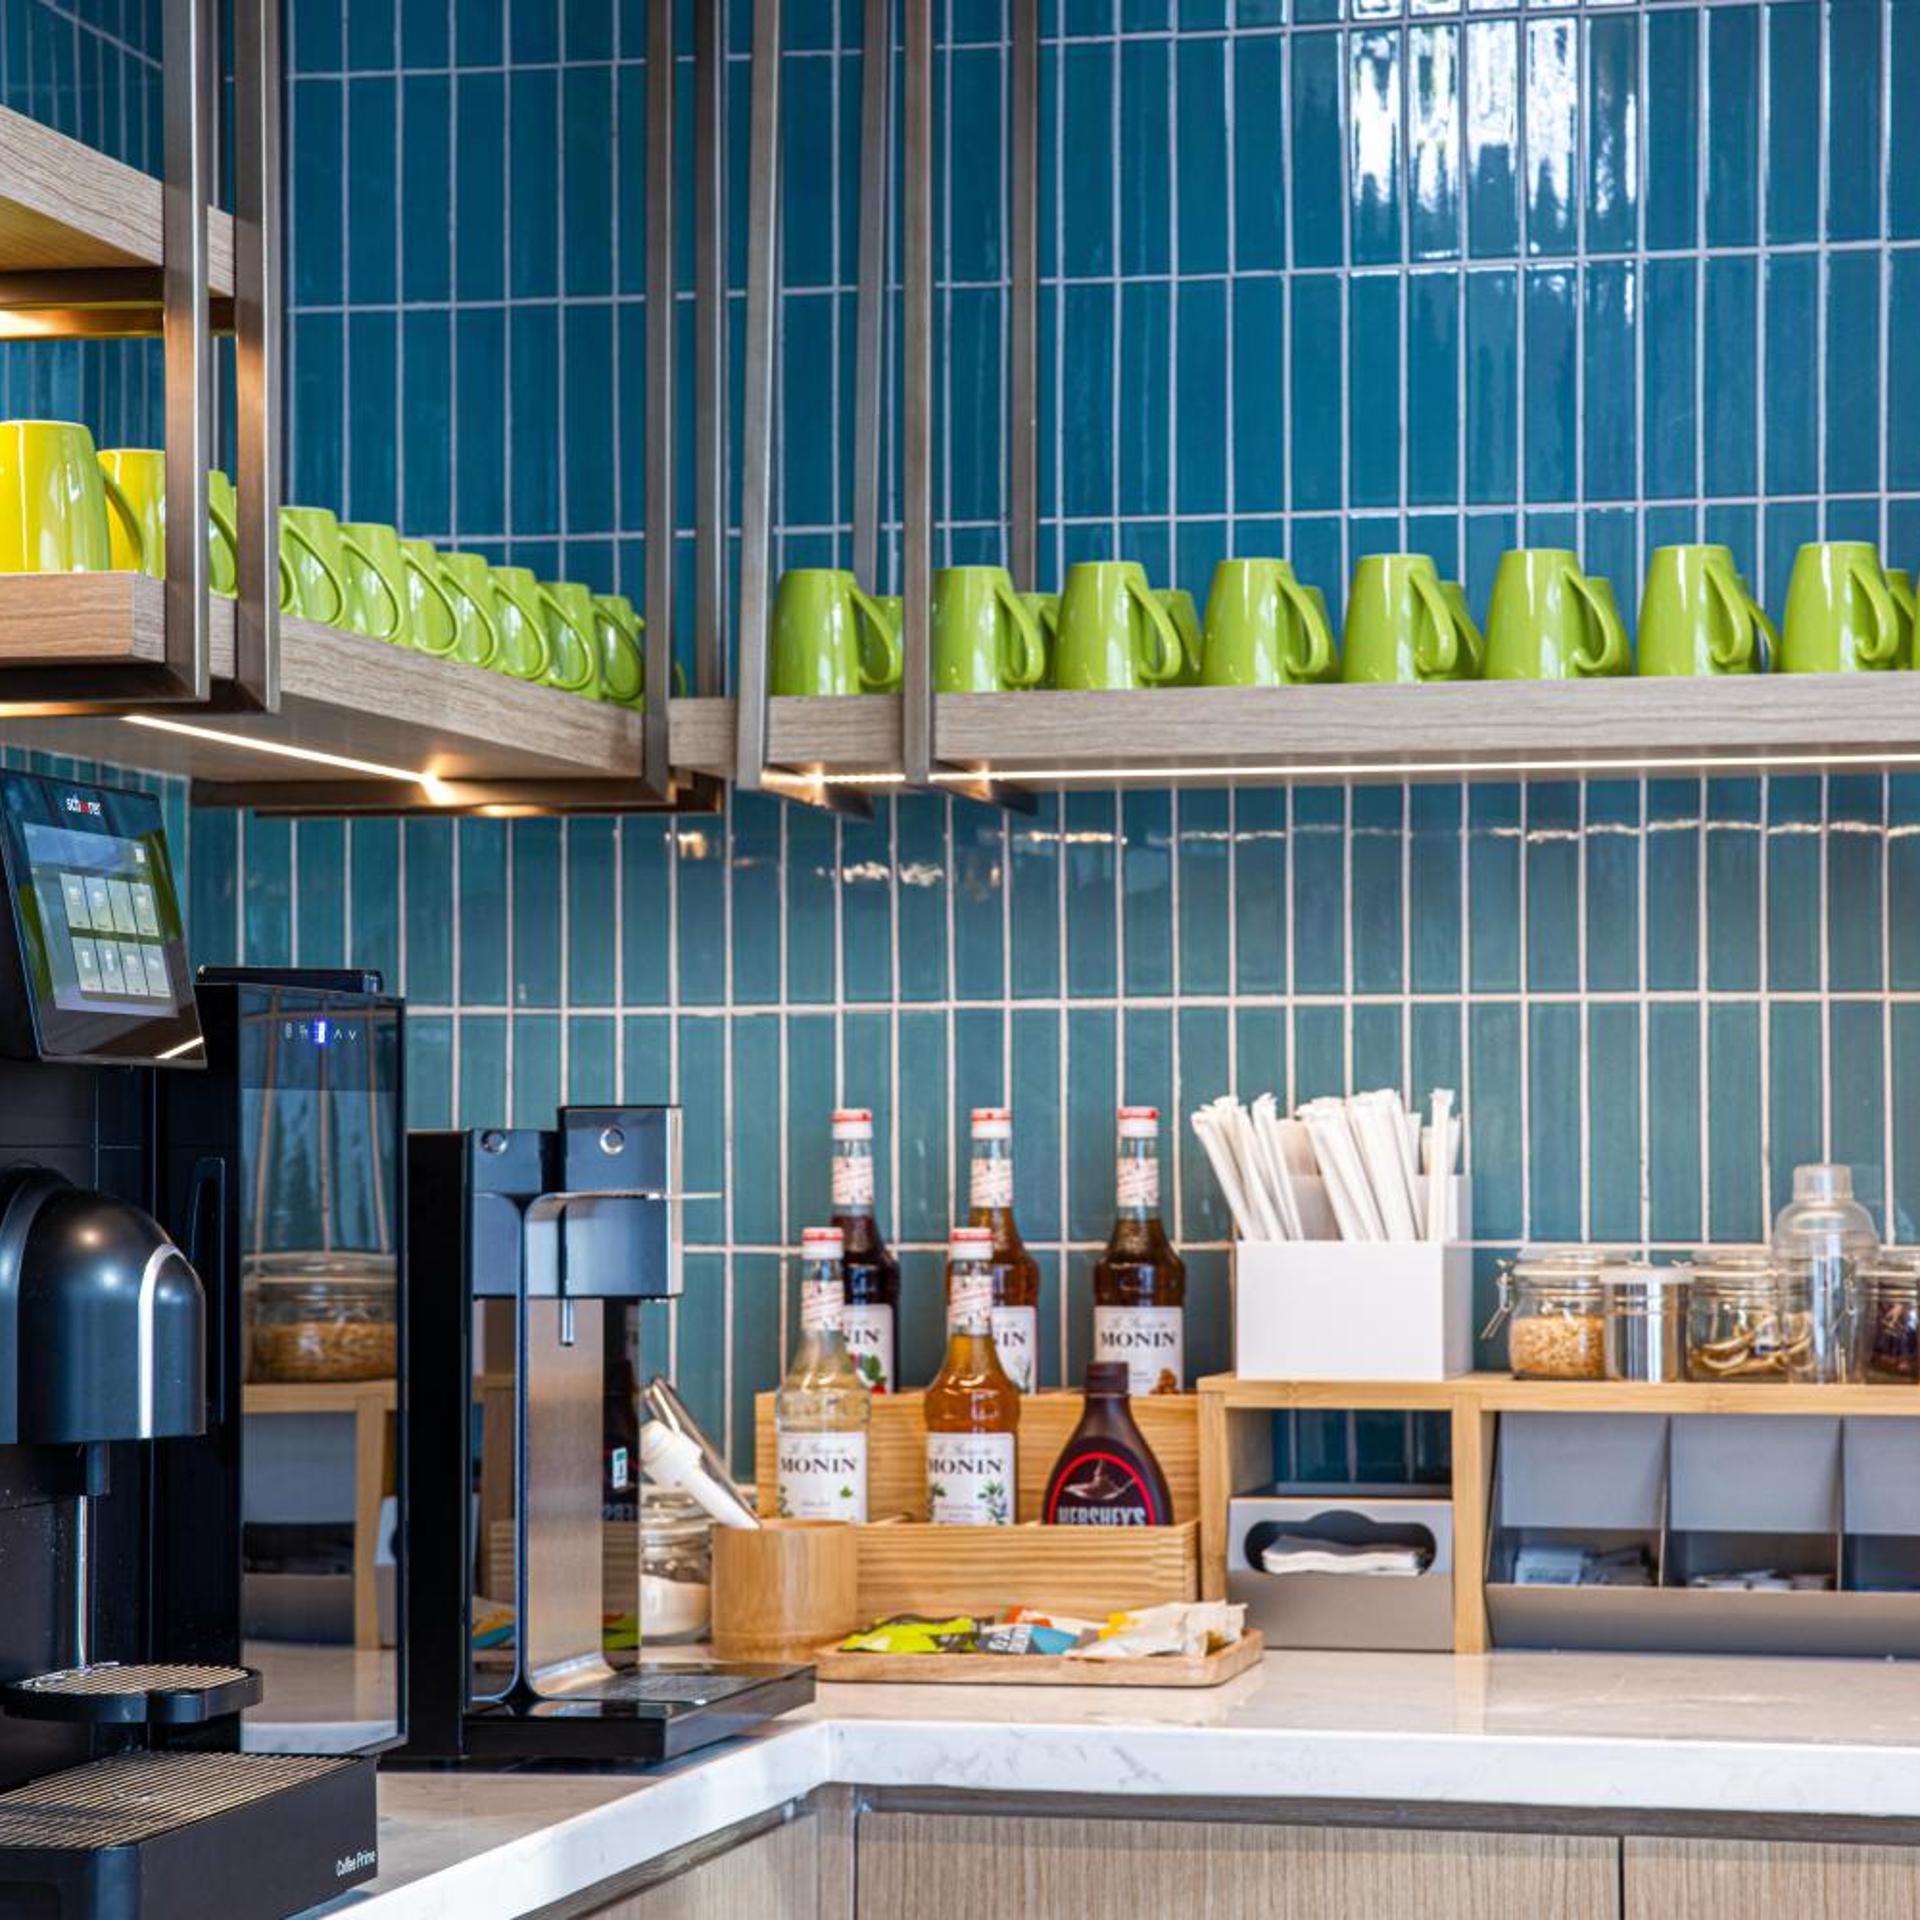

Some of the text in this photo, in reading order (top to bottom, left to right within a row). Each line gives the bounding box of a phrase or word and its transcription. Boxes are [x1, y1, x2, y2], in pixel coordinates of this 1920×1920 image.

[1101, 1331, 1176, 1348] MONIN
[780, 1458, 857, 1475] MONIN
[928, 1458, 1003, 1475] MONIN
[1056, 1506, 1147, 1526] HERSHEY'S
